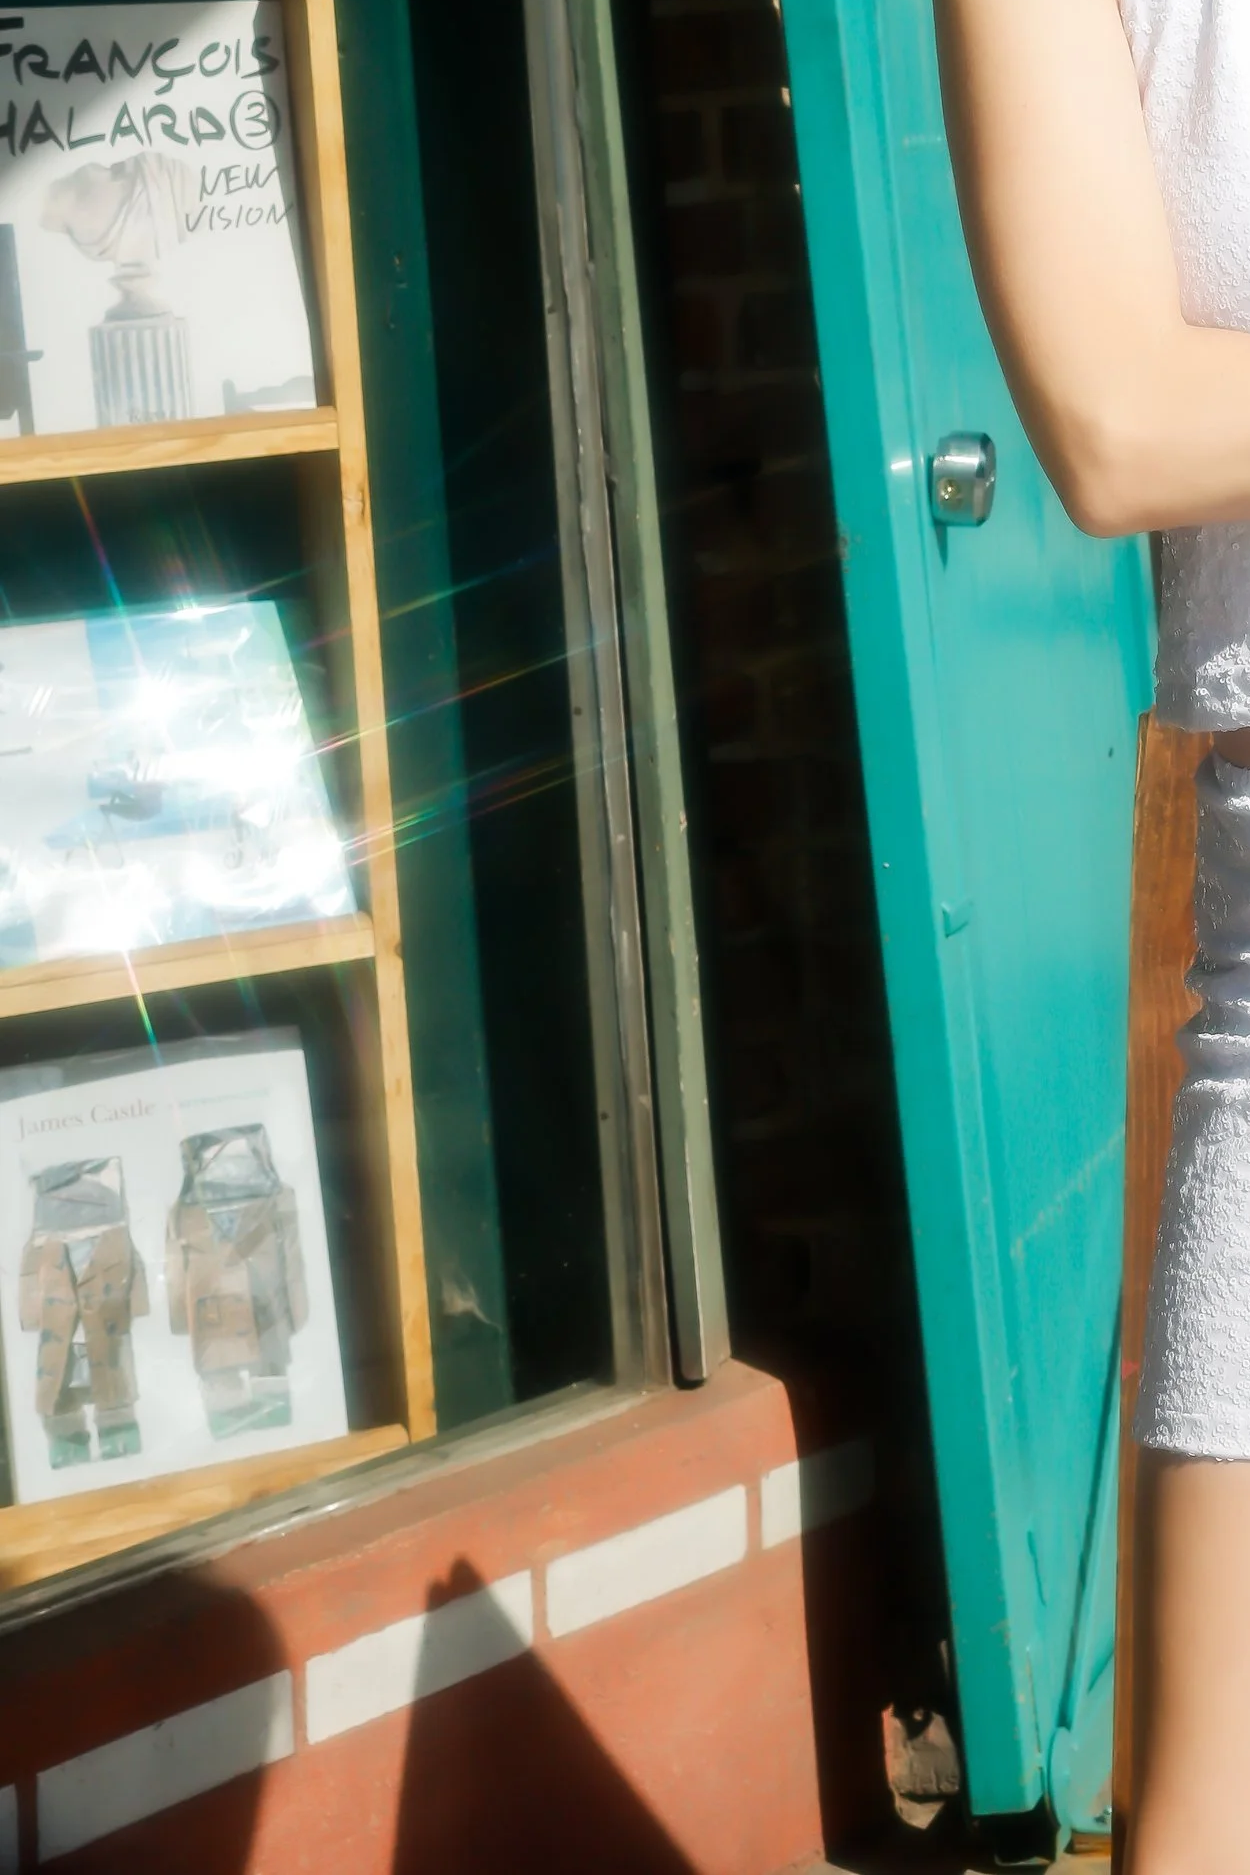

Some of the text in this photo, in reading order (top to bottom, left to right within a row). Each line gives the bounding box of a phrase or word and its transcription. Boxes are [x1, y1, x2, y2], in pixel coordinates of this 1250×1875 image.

[199, 162, 280, 202] NEW
[185, 202, 294, 233] VISION
[15, 1111, 86, 1142] James
[90, 1097, 158, 1125] Castle
